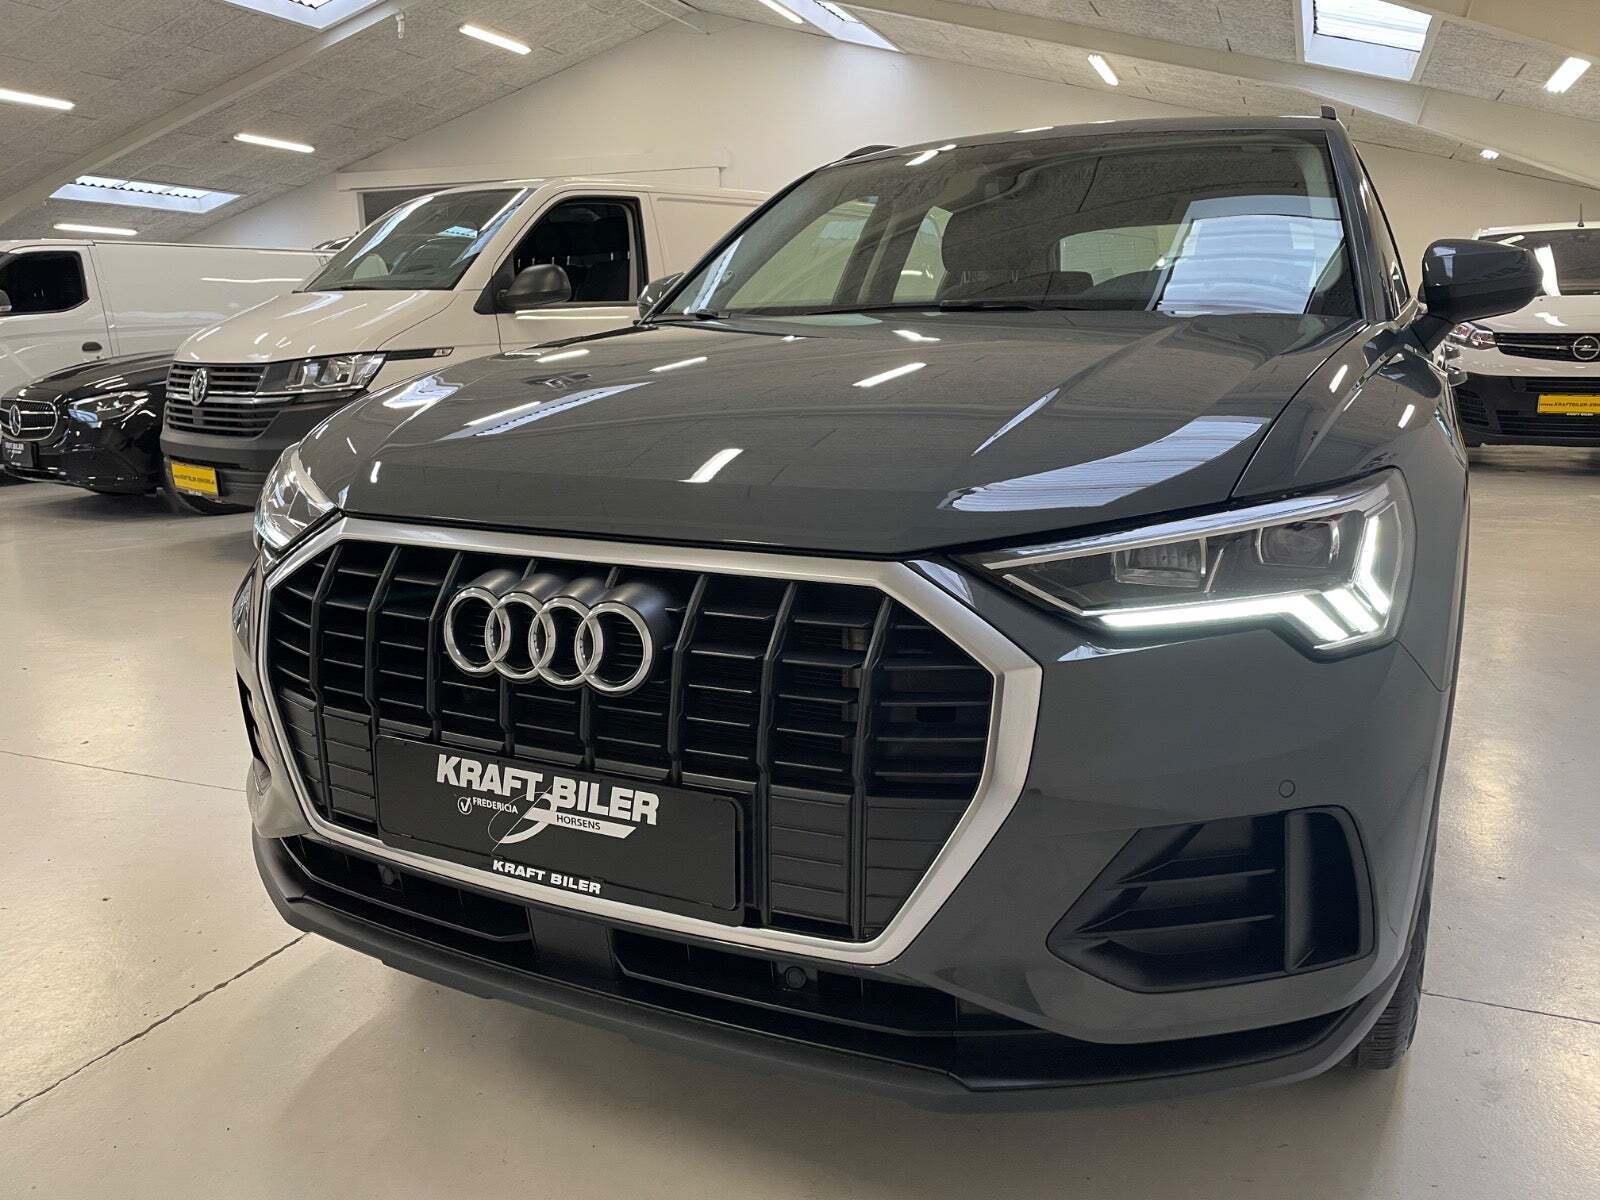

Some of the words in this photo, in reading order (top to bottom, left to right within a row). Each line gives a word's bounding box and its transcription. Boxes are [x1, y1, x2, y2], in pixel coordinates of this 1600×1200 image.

[436, 753, 543, 802] KRAFT
[551, 775, 660, 826] BILER
[472, 796, 519, 815] FREDERICIA
[556, 813, 601, 832] HORSENS
[492, 858, 546, 882] KRAFT
[550, 872, 601, 895] BILER
